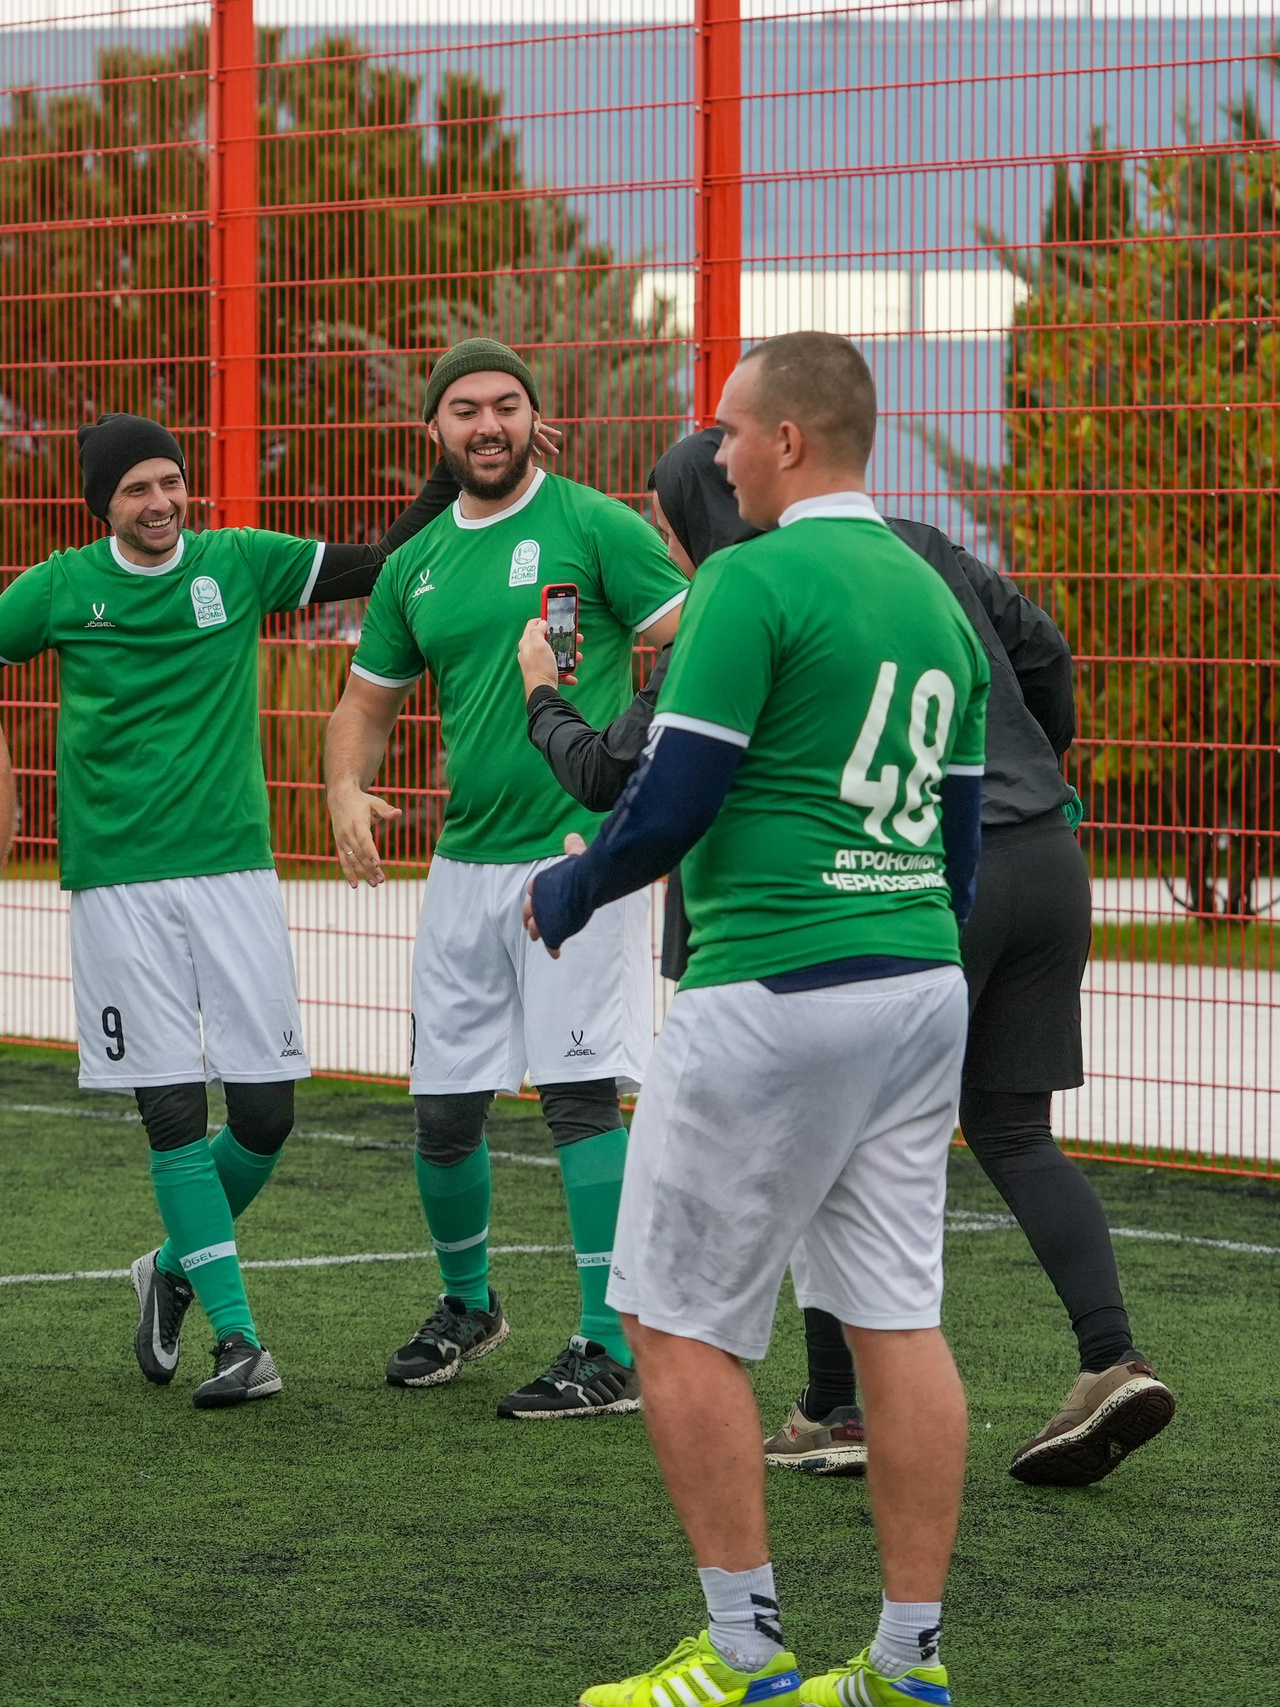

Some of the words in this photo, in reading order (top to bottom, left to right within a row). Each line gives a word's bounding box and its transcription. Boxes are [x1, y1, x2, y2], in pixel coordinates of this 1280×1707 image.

[511, 572, 536, 581] НОМЫ
[198, 609, 224, 622] НОМЫ
[84, 620, 116, 628] JÖGEL
[839, 661, 956, 847] 48
[835, 849, 936, 871] АГРОНОМЫ
[101, 1005, 126, 1062] 9
[279, 1049, 303, 1058] JÖGEL
[563, 1048, 596, 1058] JÖGEL
